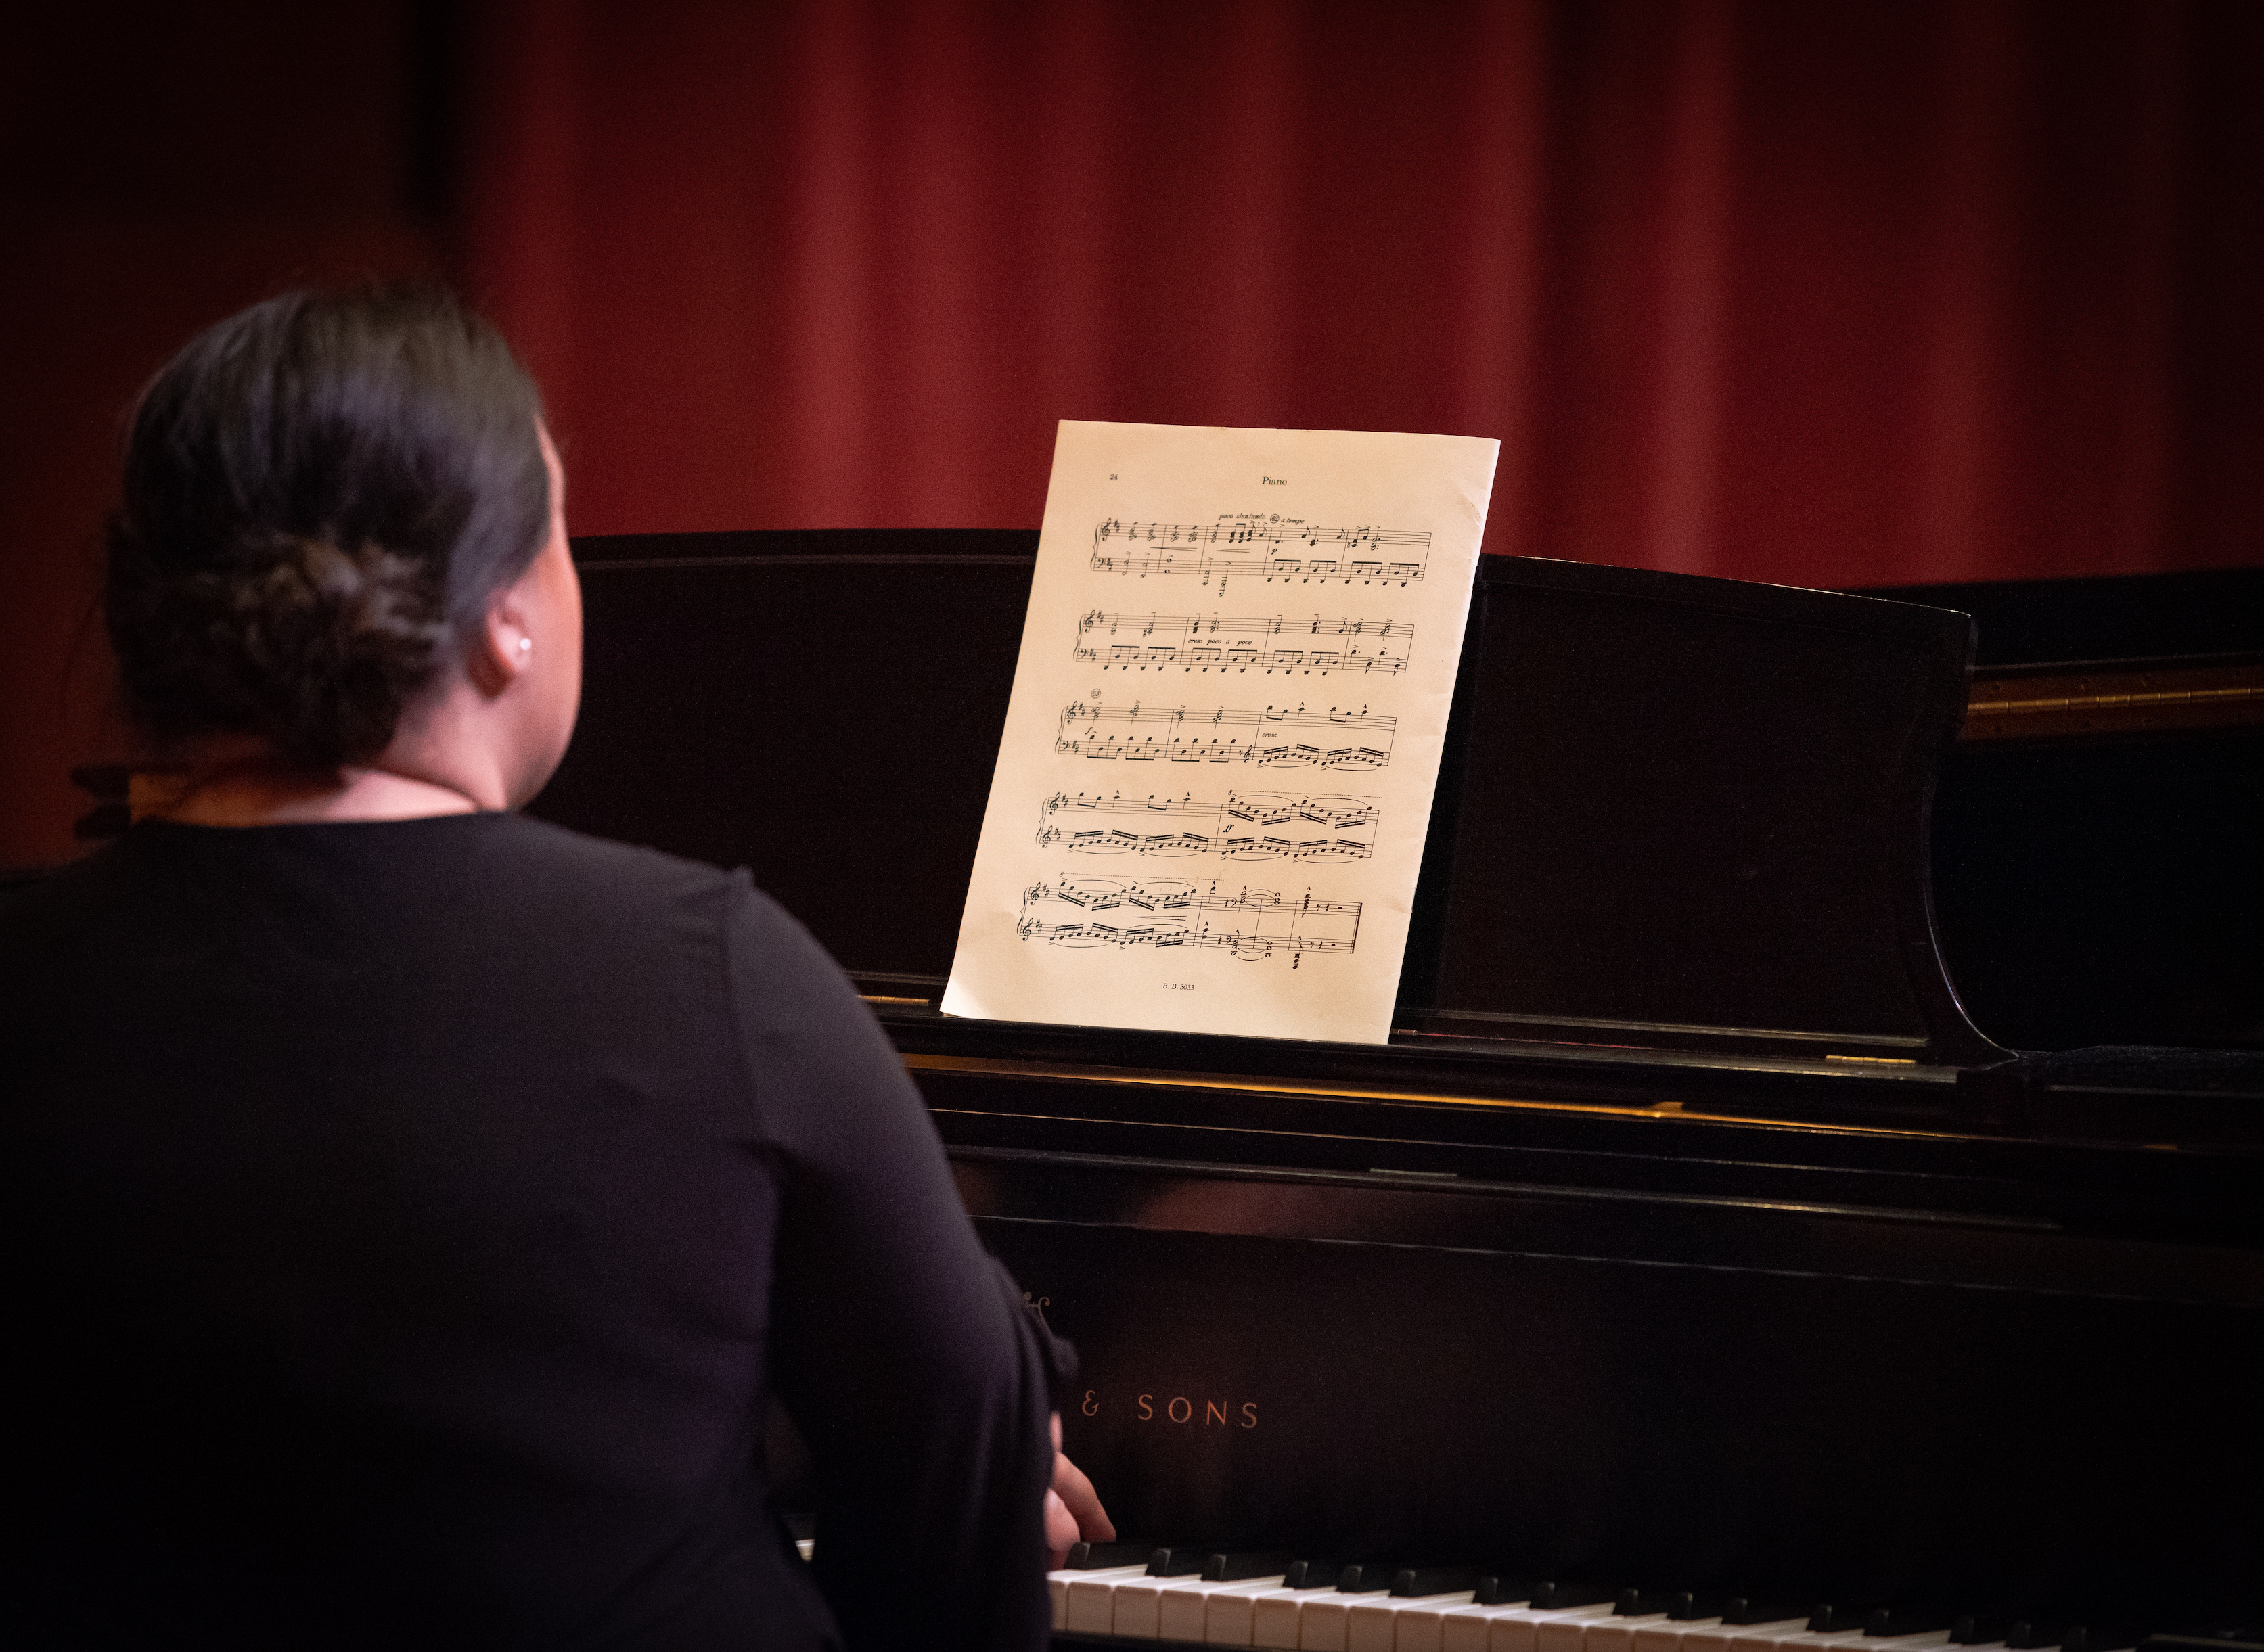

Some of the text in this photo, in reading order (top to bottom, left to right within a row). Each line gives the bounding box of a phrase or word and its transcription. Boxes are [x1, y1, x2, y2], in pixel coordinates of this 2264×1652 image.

[1262, 476, 1288, 486] Piano
[1081, 1390, 1259, 1429] & SONS
